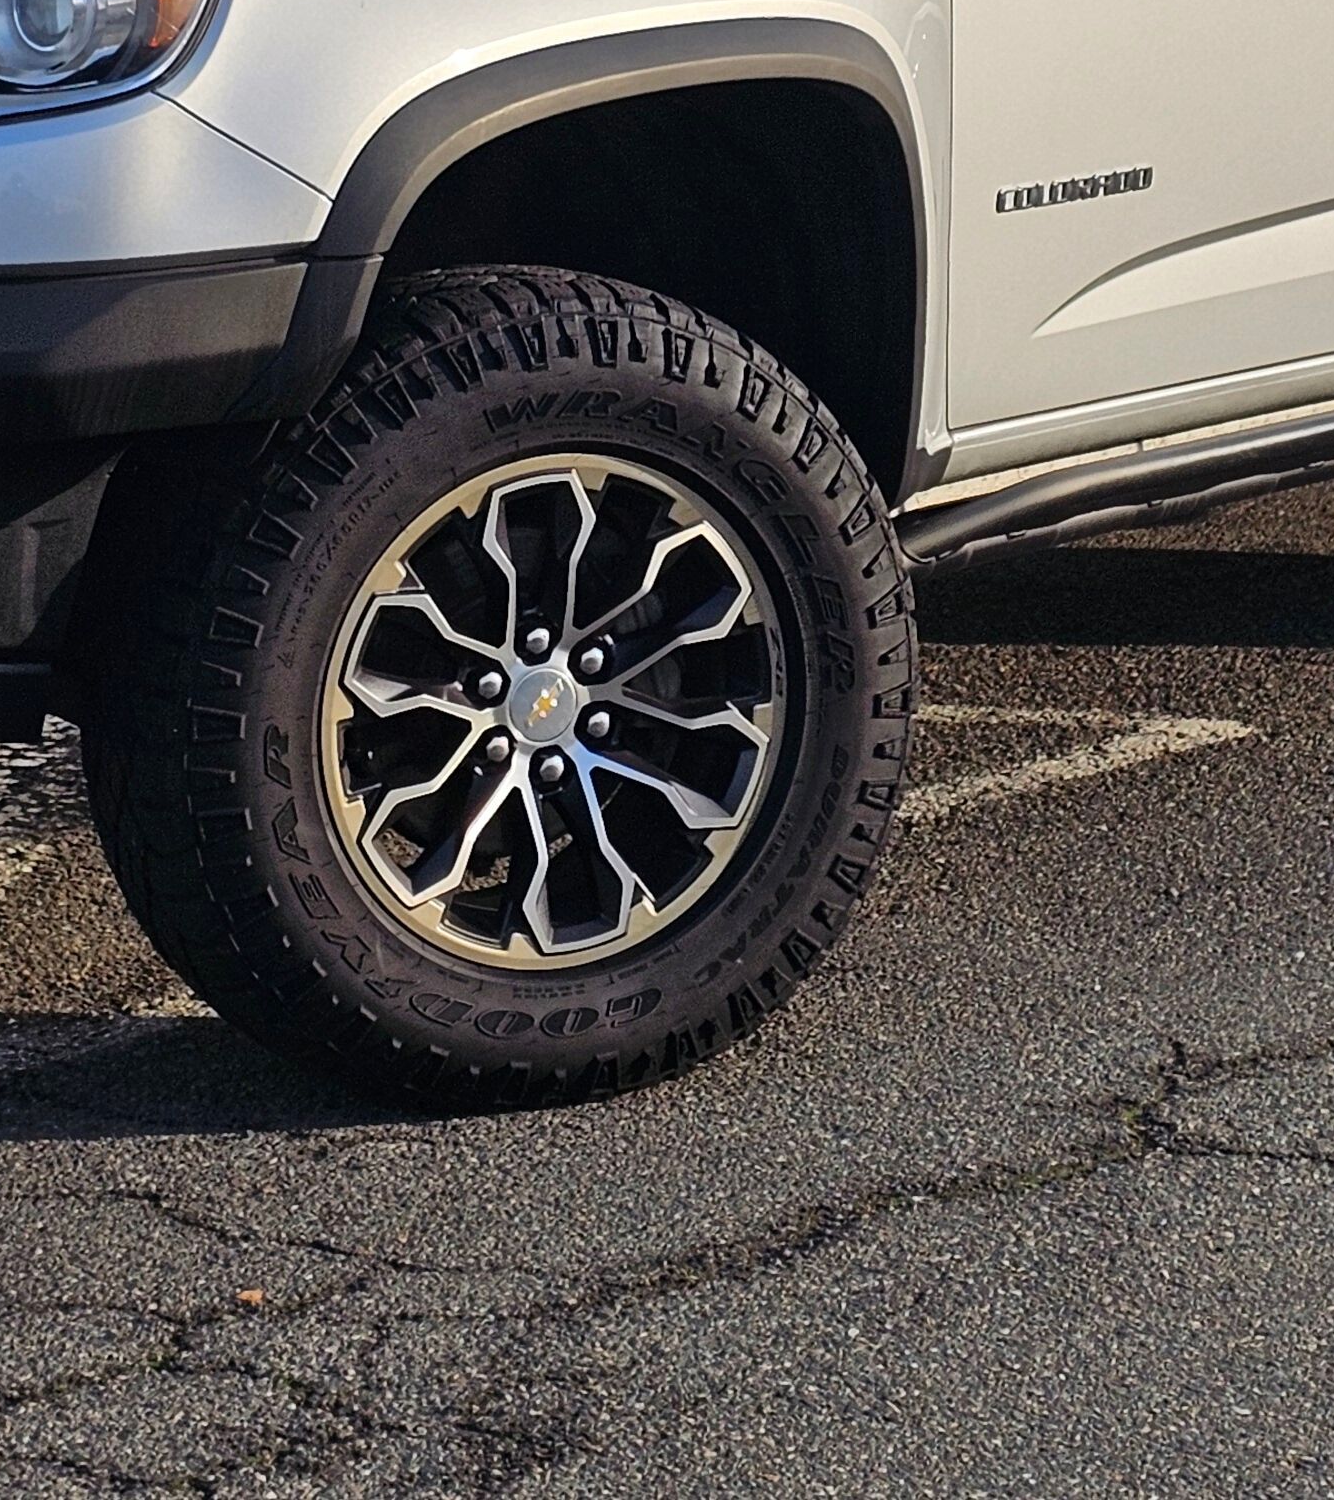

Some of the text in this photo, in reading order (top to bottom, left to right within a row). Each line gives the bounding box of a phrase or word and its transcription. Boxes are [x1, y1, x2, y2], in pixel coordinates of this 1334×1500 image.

[995, 166, 1154, 214] COLORADO
[483, 388, 856, 694] WRANGLER
[264, 723, 663, 1038] GOODYEAR
